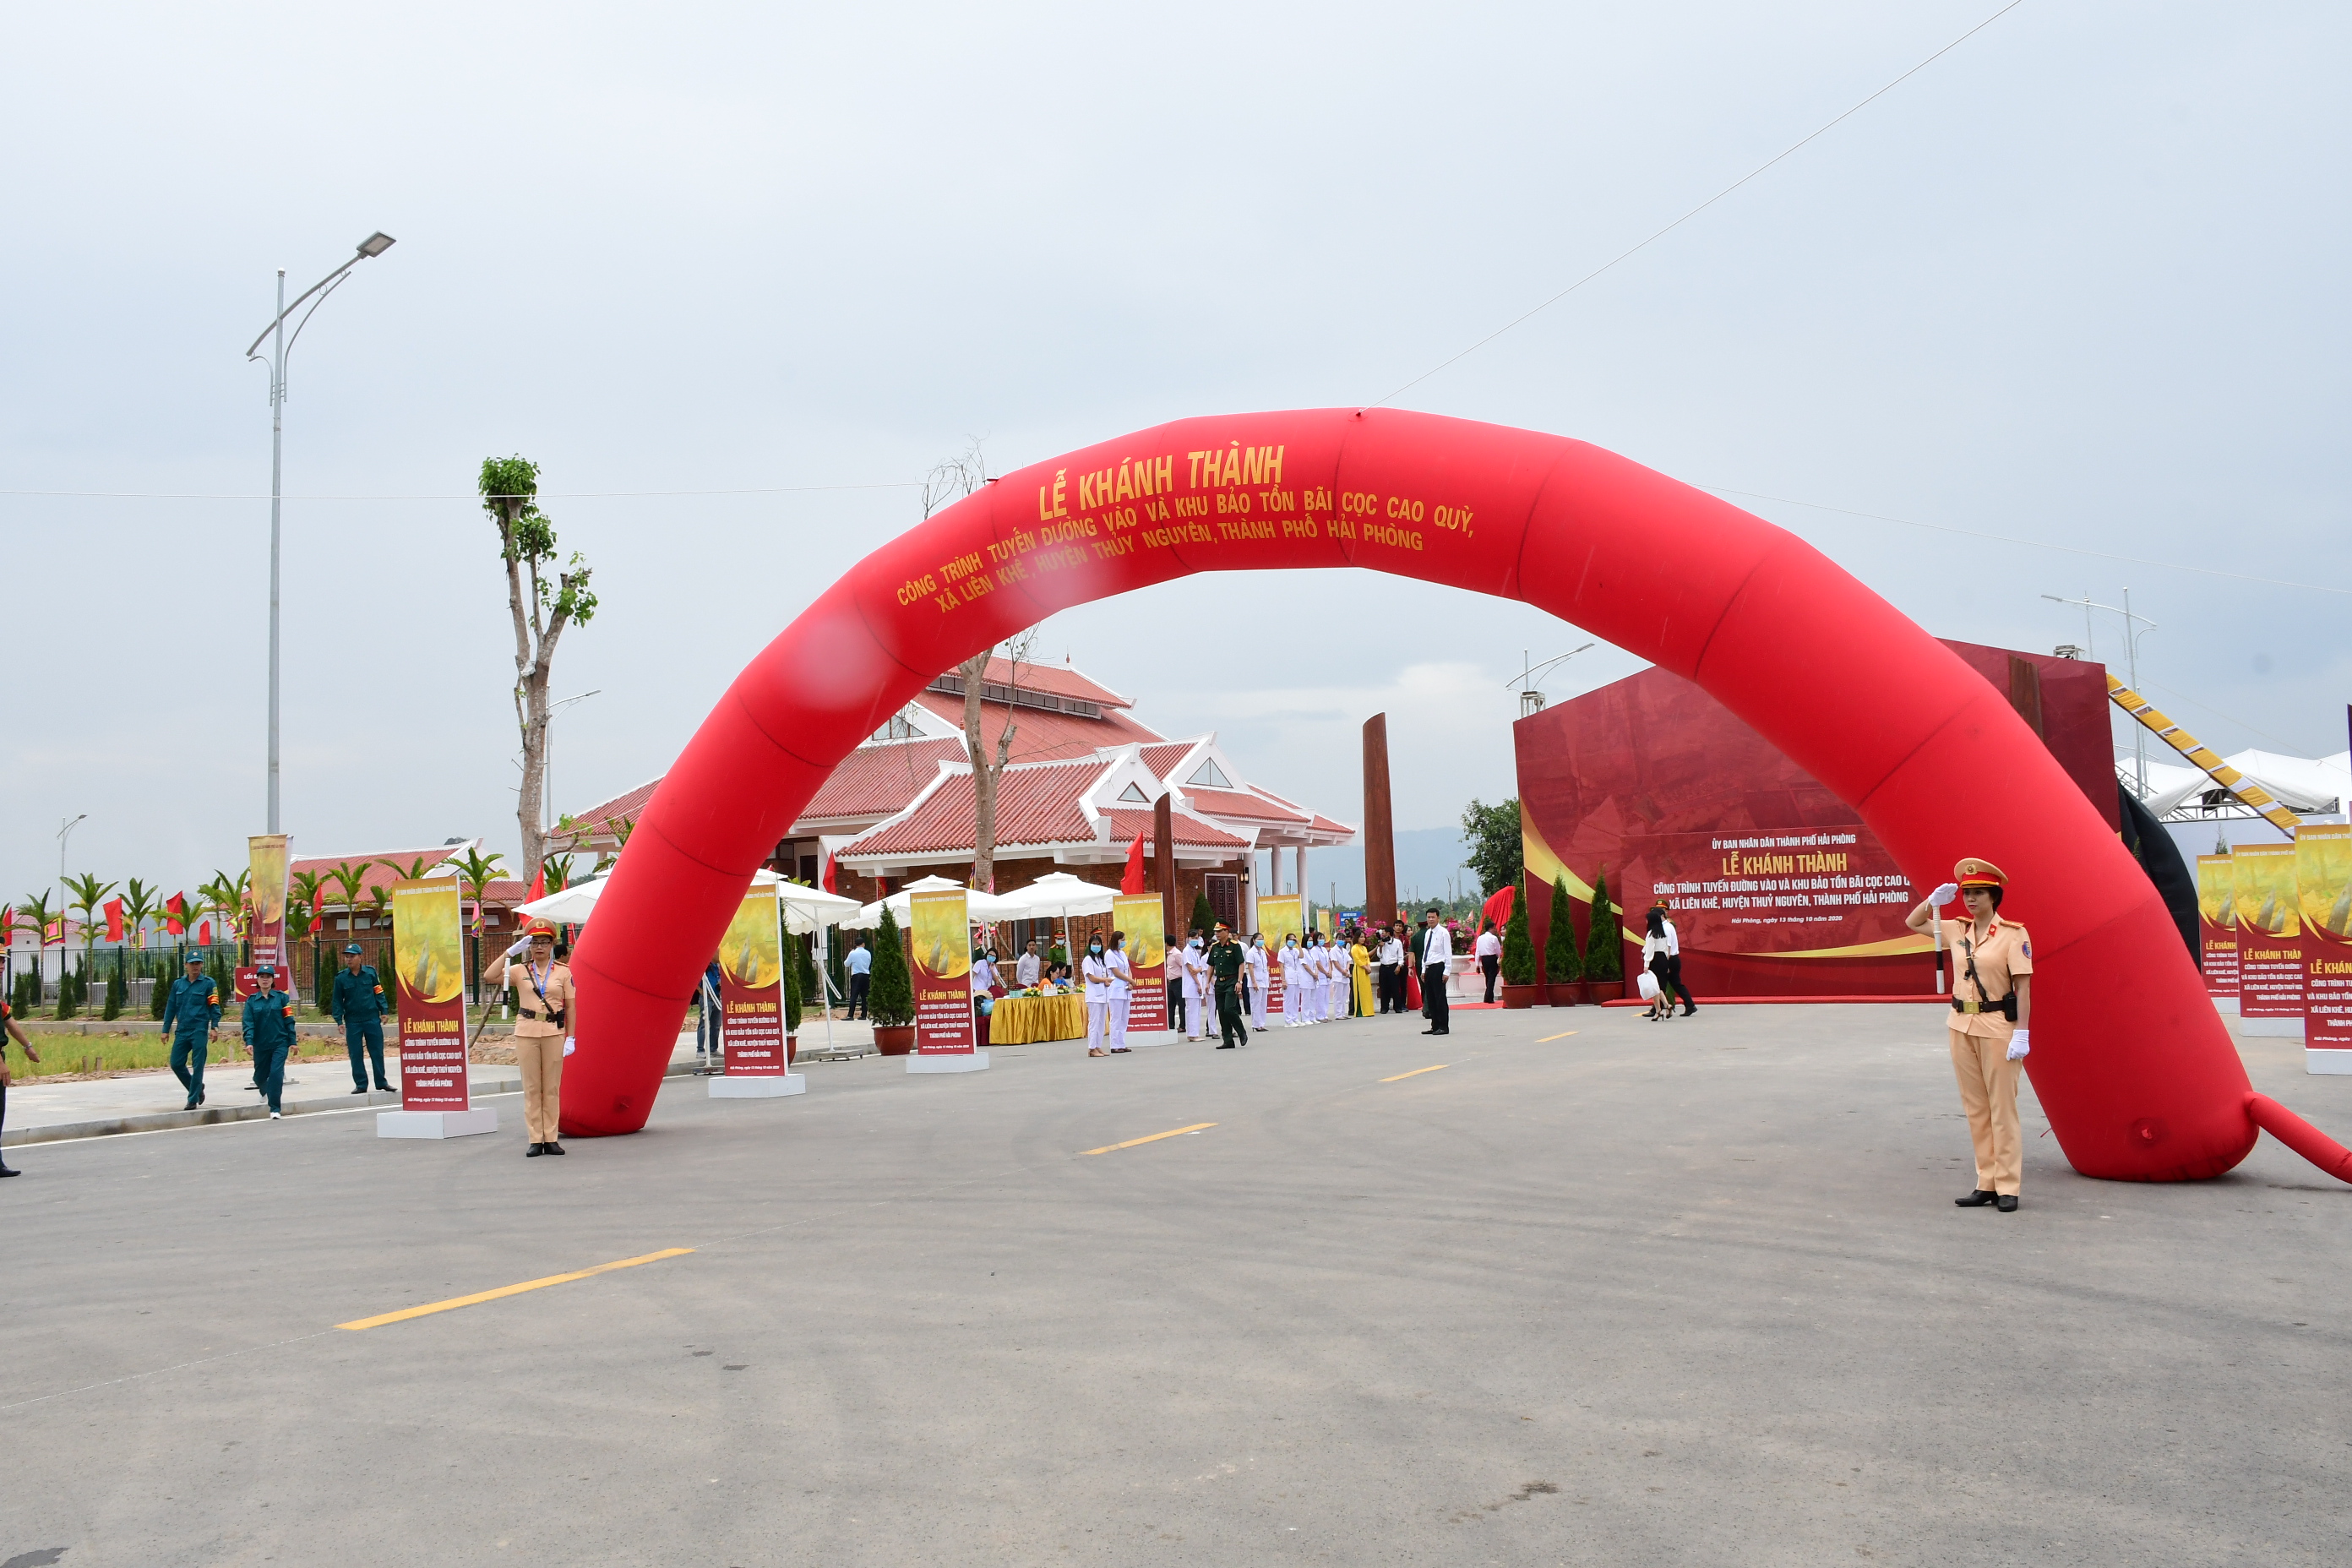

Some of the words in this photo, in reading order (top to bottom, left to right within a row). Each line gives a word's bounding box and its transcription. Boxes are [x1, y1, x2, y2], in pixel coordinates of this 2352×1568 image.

[1039, 468, 1067, 520] LỄ
[1079, 456, 1173, 510] KHÁNH
[1187, 439, 1285, 488] THÀNH
[897, 574, 937, 606] CÔNG
[939, 552, 983, 585] TRÌNH
[987, 526, 1037, 564] TUYẾN
[1041, 516, 1097, 547] ĐƯỜNG
[1102, 505, 1137, 531] VÀO
[1145, 497, 1170, 521] VÀ
[1174, 496, 1208, 518] KHU
[1217, 486, 1250, 514] BẢO
[1260, 483, 1295, 512] TỒN
[1304, 486, 1332, 511] BÃI
[1342, 492, 1377, 517] CỌC
[1386, 497, 1424, 522] CAO
[1435, 505, 1474, 538] QUỲ,
[934, 588, 961, 613] XÃ
[959, 574, 994, 602] LIÊN
[1035, 545, 1089, 573] HUYỆN
[1092, 529, 1135, 559] THỦY
[1142, 521, 1218, 548] NGUYÊN,
[1217, 516, 1276, 541] THÀNH
[1282, 513, 1318, 538] PHỐ
[1326, 514, 1356, 540] HẢI
[1363, 523, 1424, 551] PHÒNG
[1712, 837, 1722, 850] ỦY
[1723, 839, 1738, 849] BAN
[1739, 837, 1758, 848] NHÂN
[1760, 836, 1775, 847] DÂN
[1776, 835, 1800, 847] THÀNH
[1801, 833, 1817, 846] PHỐ
[1817, 832, 1830, 845] HẢI
[1831, 832, 1856, 844] PHÒNG
[1723, 851, 1740, 876] LỄ
[1743, 852, 1793, 875] KHÁNH
[1796, 850, 1847, 874] THÀNH
[1653, 881, 1674, 894] CÔNG
[1676, 880, 1701, 893] TRÌNH
[1702, 879, 1729, 893] TUYẾN
[1730, 879, 1758, 892] ĐƯỜNG
[1760, 878, 1777, 891] VÀO
[1778, 877, 1790, 890] VÀ
[1792, 879, 1809, 890] KHU
[1810, 874, 1828, 890] BẢO
[1848, 874, 1864, 888] BÃI
[1865, 875, 1882, 889] CỌC
[1884, 875, 1902, 887] CAO
[1669, 897, 1680, 910] XÃ
[1682, 896, 1700, 910] LIÊN
[1701, 896, 1720, 909] KHÊ,
[1723, 895, 1750, 910] HUYỆN
[1751, 893, 1773, 907] THUỶ
[1775, 893, 1811, 907] NGUYÊN,
[1813, 892, 1842, 906] THÀNH
[1843, 890, 1862, 905] PHỐ
[1863, 890, 1877, 904] HẢI
[1879, 890, 1908, 903] PHÒNG
[2206, 939, 2213, 950] LỄ
[2215, 940, 2236, 950] KHÁNH
[2243, 948, 2253, 960] LỄ
[2255, 949, 2281, 960] KHÁNH
[2283, 948, 2302, 960] THÀN
[2311, 959, 2322, 974] LỄ
[2325, 960, 2352, 974] KHÁN
[1145, 977, 1162, 986] THÀNH
[920, 989, 927, 1000] LỄ
[928, 990, 946, 1000] KHÁNH
[947, 989, 966, 999] THÀNH
[727, 1000, 734, 1013] LỄ
[735, 1002, 755, 1013] KHÁNH
[756, 1001, 776, 1012] THÀNH
[404, 1018, 412, 1033] LỄ
[413, 1019, 435, 1033] KHÁNH
[436, 1018, 459, 1032] THÀNH
